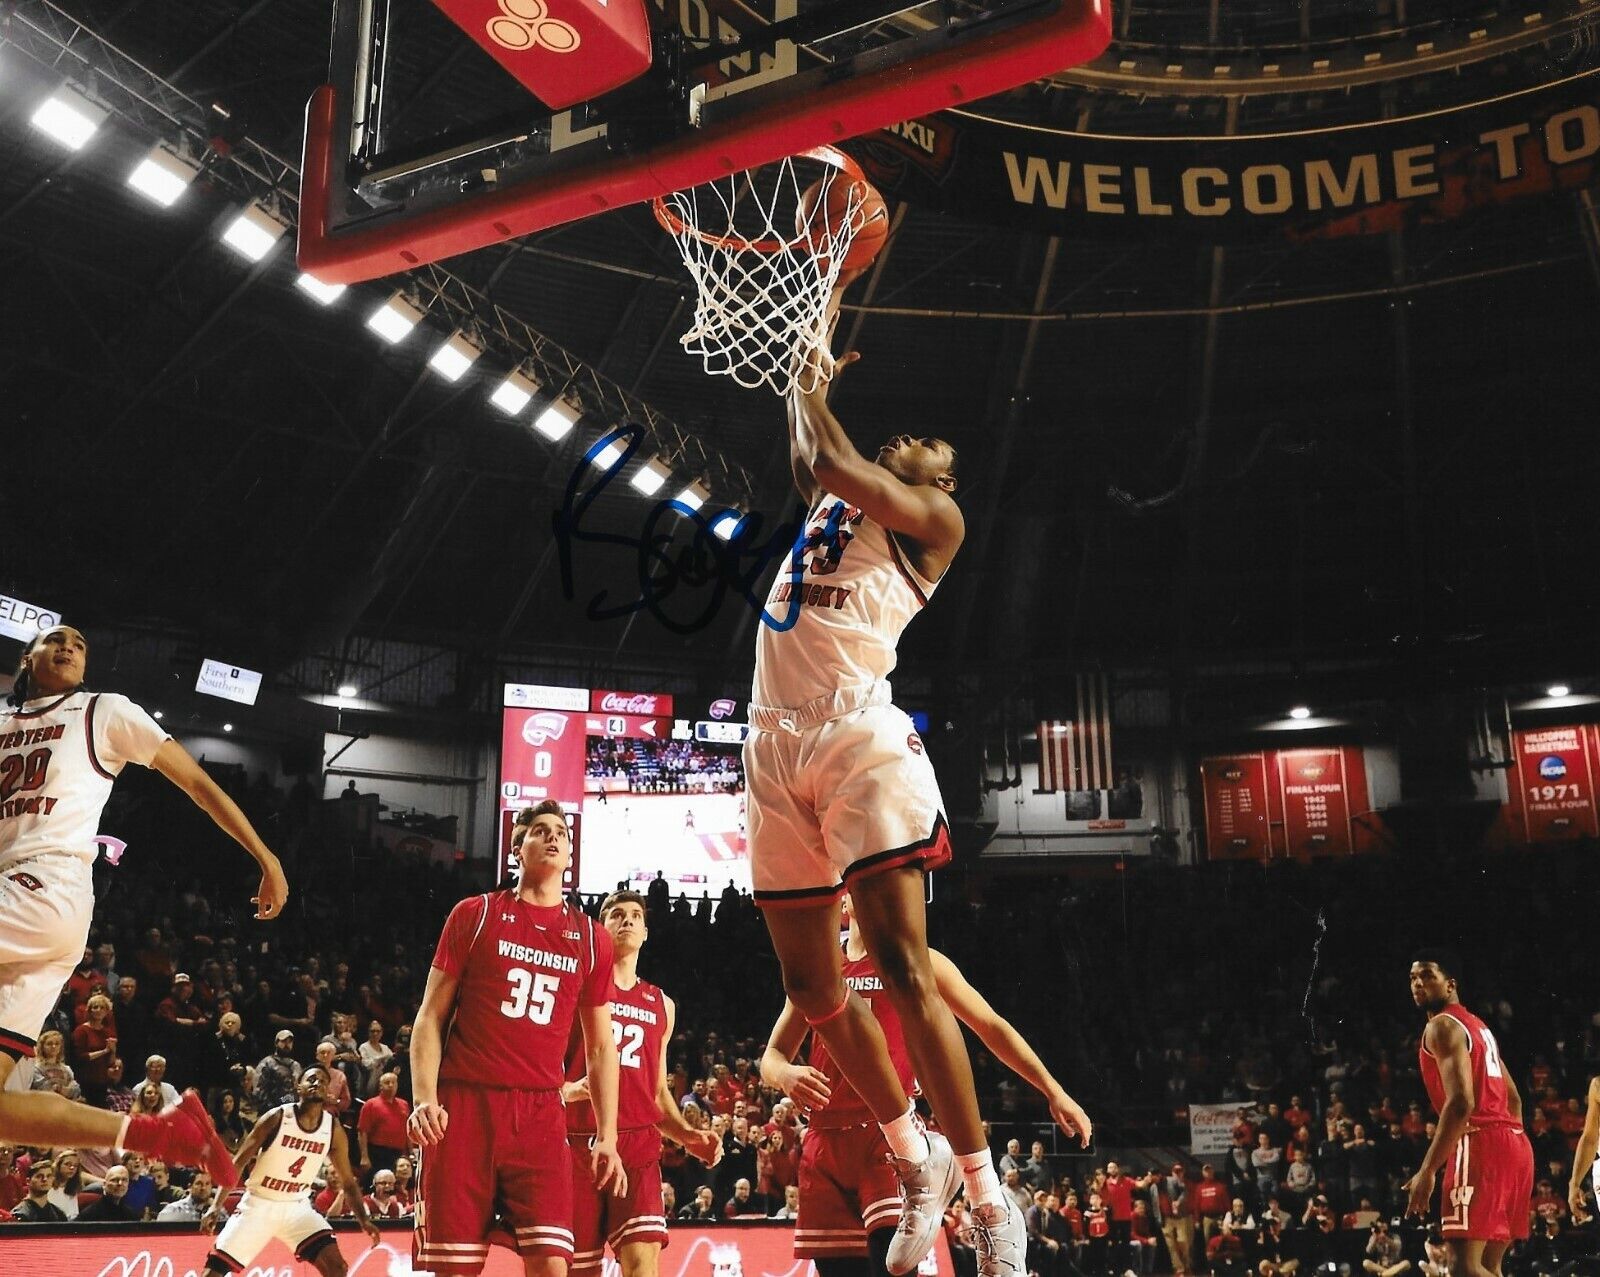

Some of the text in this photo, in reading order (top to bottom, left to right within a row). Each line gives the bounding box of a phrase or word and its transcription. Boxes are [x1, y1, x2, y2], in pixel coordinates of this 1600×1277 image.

[1003, 104, 1600, 217] WELCOME TO
[205, 664, 228, 678] First
[200, 676, 245, 695] Southern
[0, 747, 52, 803] 20
[1286, 784, 1341, 795] FINAL FOUR
[1529, 784, 1580, 801] 1971
[1530, 800, 1589, 811] FINAL FOUR
[498, 939, 578, 974] WISCONSIN
[500, 967, 560, 1026] 35
[281, 1135, 325, 1155] WESTERN
[288, 1155, 307, 1178] 4
